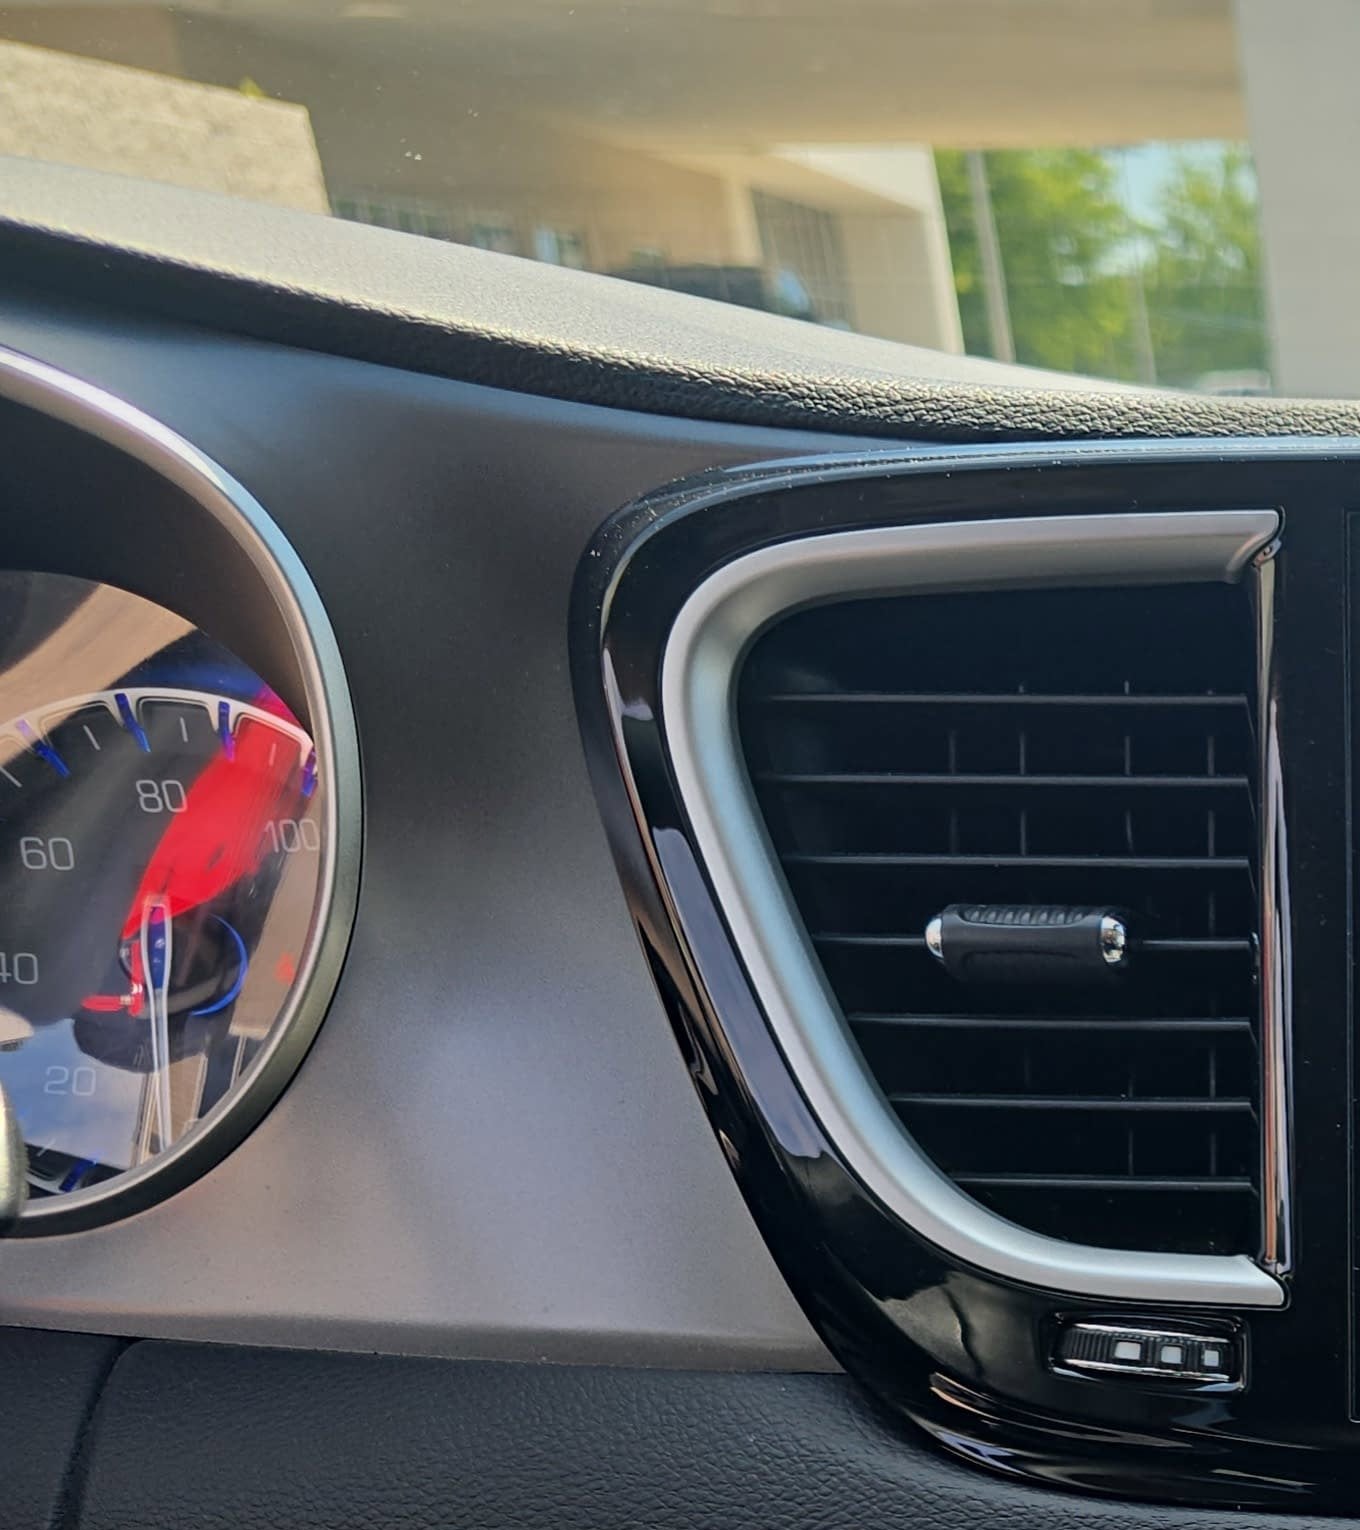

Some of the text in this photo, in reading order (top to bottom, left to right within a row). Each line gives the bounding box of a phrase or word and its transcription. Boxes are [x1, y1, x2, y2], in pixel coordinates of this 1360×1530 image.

[136, 780, 189, 814] 80
[263, 817, 320, 853] 100
[20, 836, 75, 871] 60
[43, 1065, 97, 1097] 20
